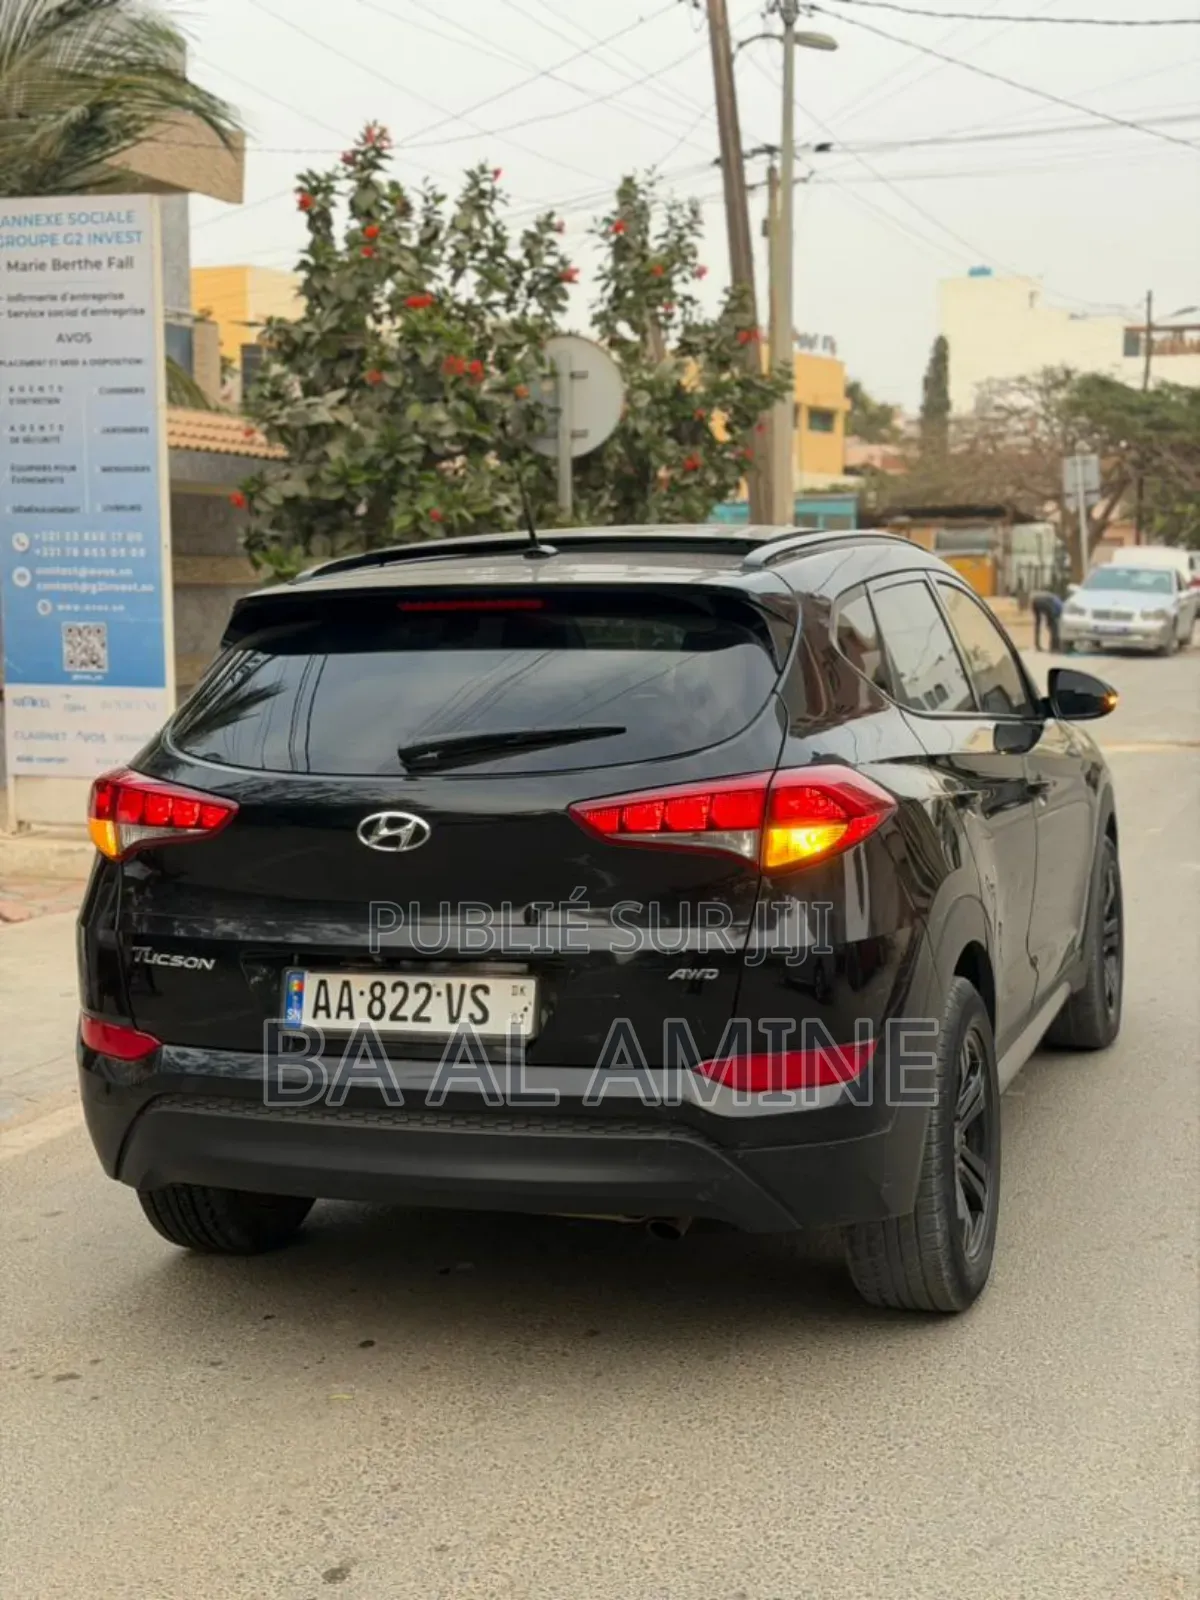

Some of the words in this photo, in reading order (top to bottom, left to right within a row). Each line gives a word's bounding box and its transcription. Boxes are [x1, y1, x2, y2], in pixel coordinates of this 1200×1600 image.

[0, 213, 63, 227] ANNEXE
[67, 211, 135, 225] SOCIALE
[63, 232, 83, 246] G2
[89, 230, 142, 245] INVEST
[7, 259, 46, 272] Marie
[52, 258, 102, 271] Berthe
[107, 256, 134, 269] Fall
[7, 309, 45, 318] Service
[56, 331, 92, 344] AVOS
[132, 946, 216, 971] TUCSON
[667, 968, 719, 980] AWD
